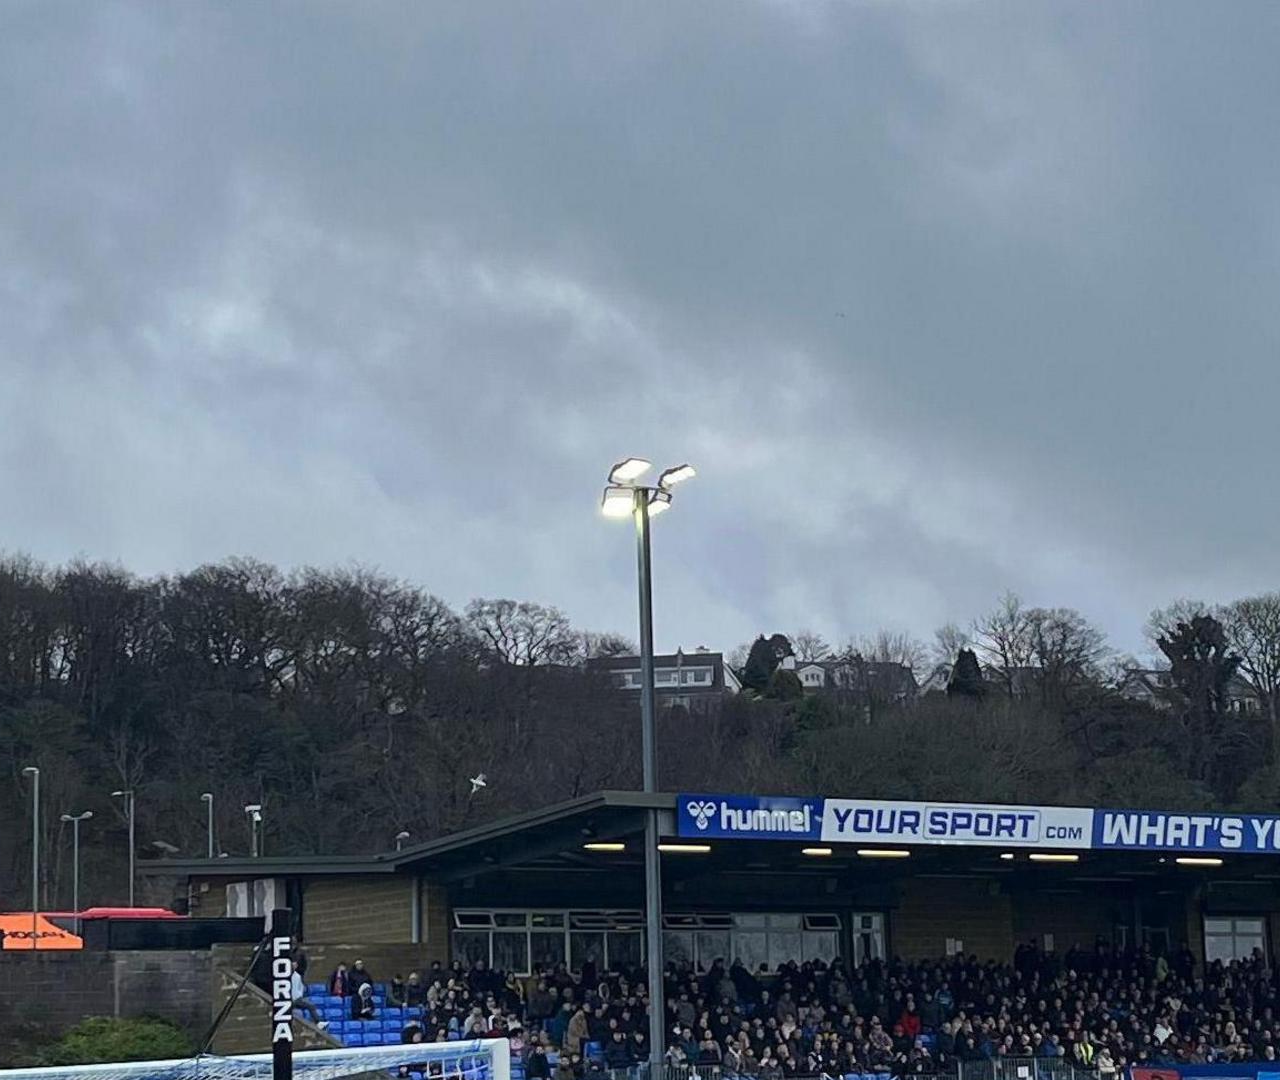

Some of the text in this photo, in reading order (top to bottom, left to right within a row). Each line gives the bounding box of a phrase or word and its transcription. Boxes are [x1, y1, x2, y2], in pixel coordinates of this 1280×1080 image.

[721, 802, 811, 833] hummel
[1102, 812, 1243, 849] WHAT'S
[273, 936, 293, 1042] FORZA
